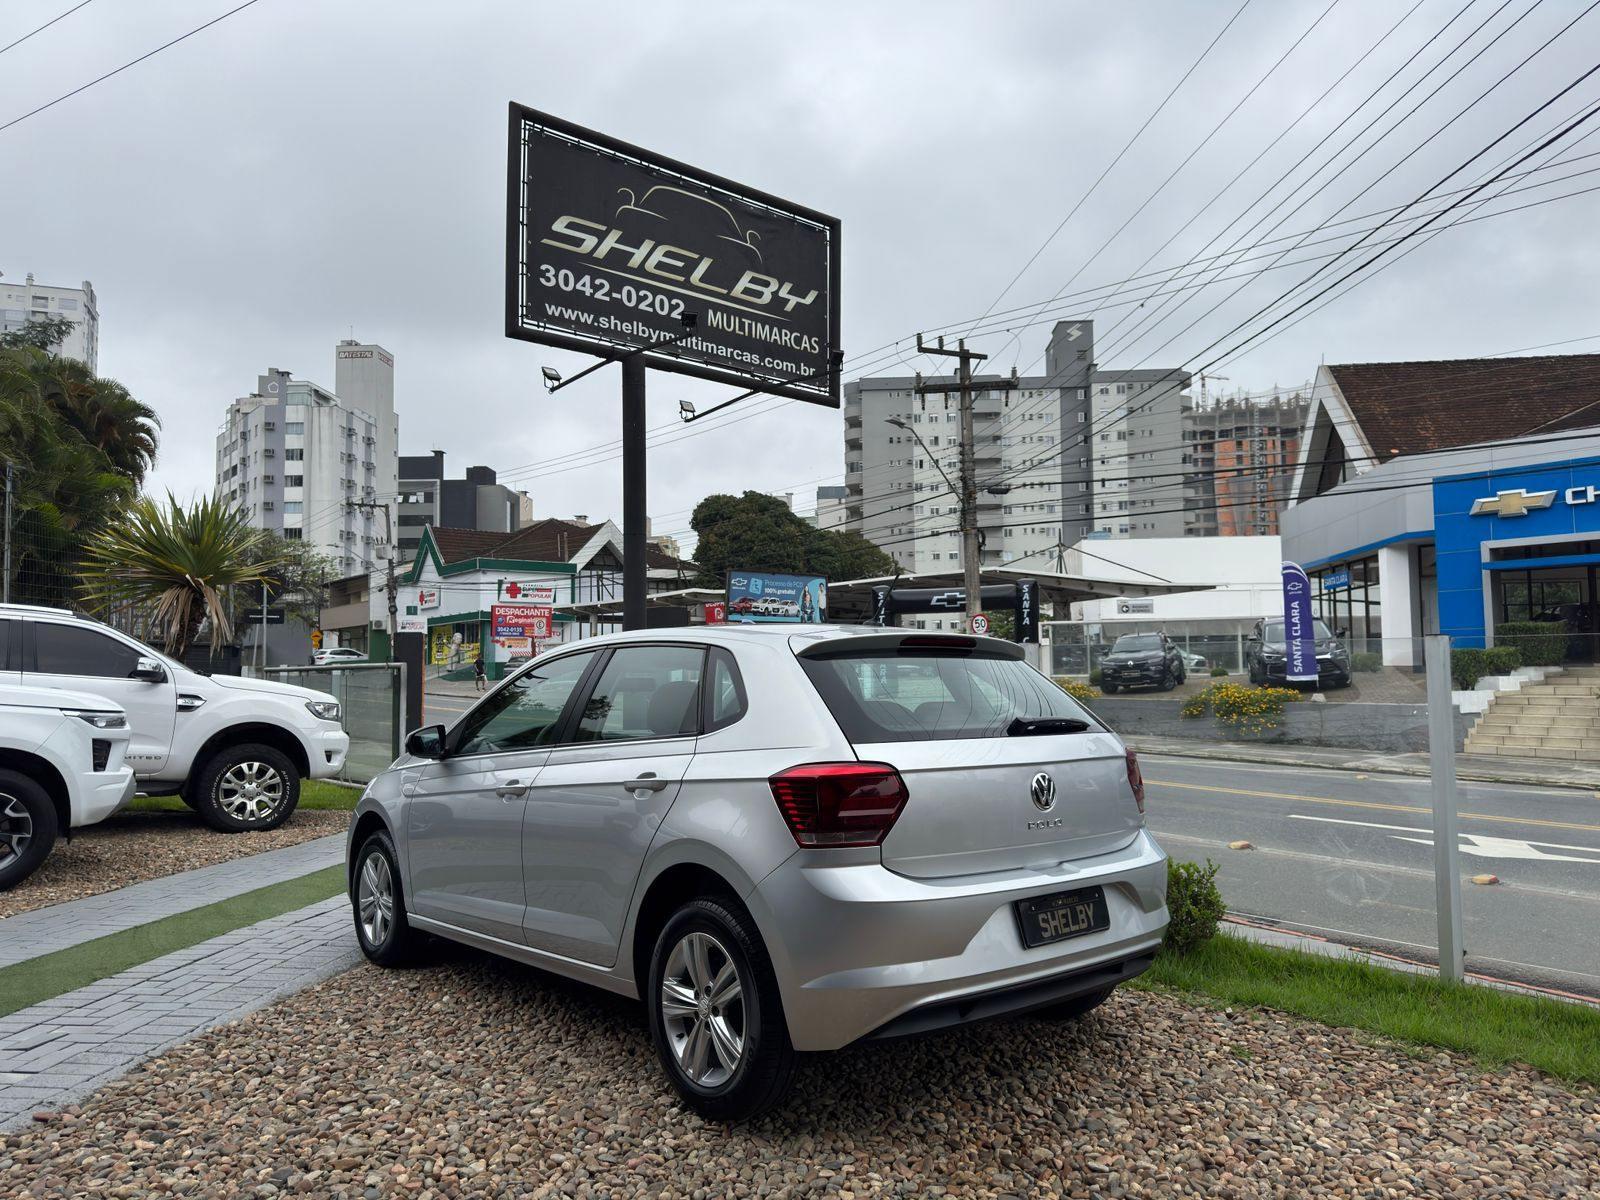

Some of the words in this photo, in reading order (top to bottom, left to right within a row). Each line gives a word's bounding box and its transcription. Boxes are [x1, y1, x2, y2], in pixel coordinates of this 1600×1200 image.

[540, 215, 819, 312] SHELBY
[539, 263, 685, 320] 3042-0202
[707, 308, 820, 354] MULTIMARCAS
[495, 607, 550, 617] DESPACHANTE
[1022, 584, 1031, 626] SANTA
[1291, 600, 1302, 636] CLARA
[974, 618, 985, 629] 50
[1294, 637, 1304, 673] SANTA
[1038, 902, 1095, 938] SHELBY
